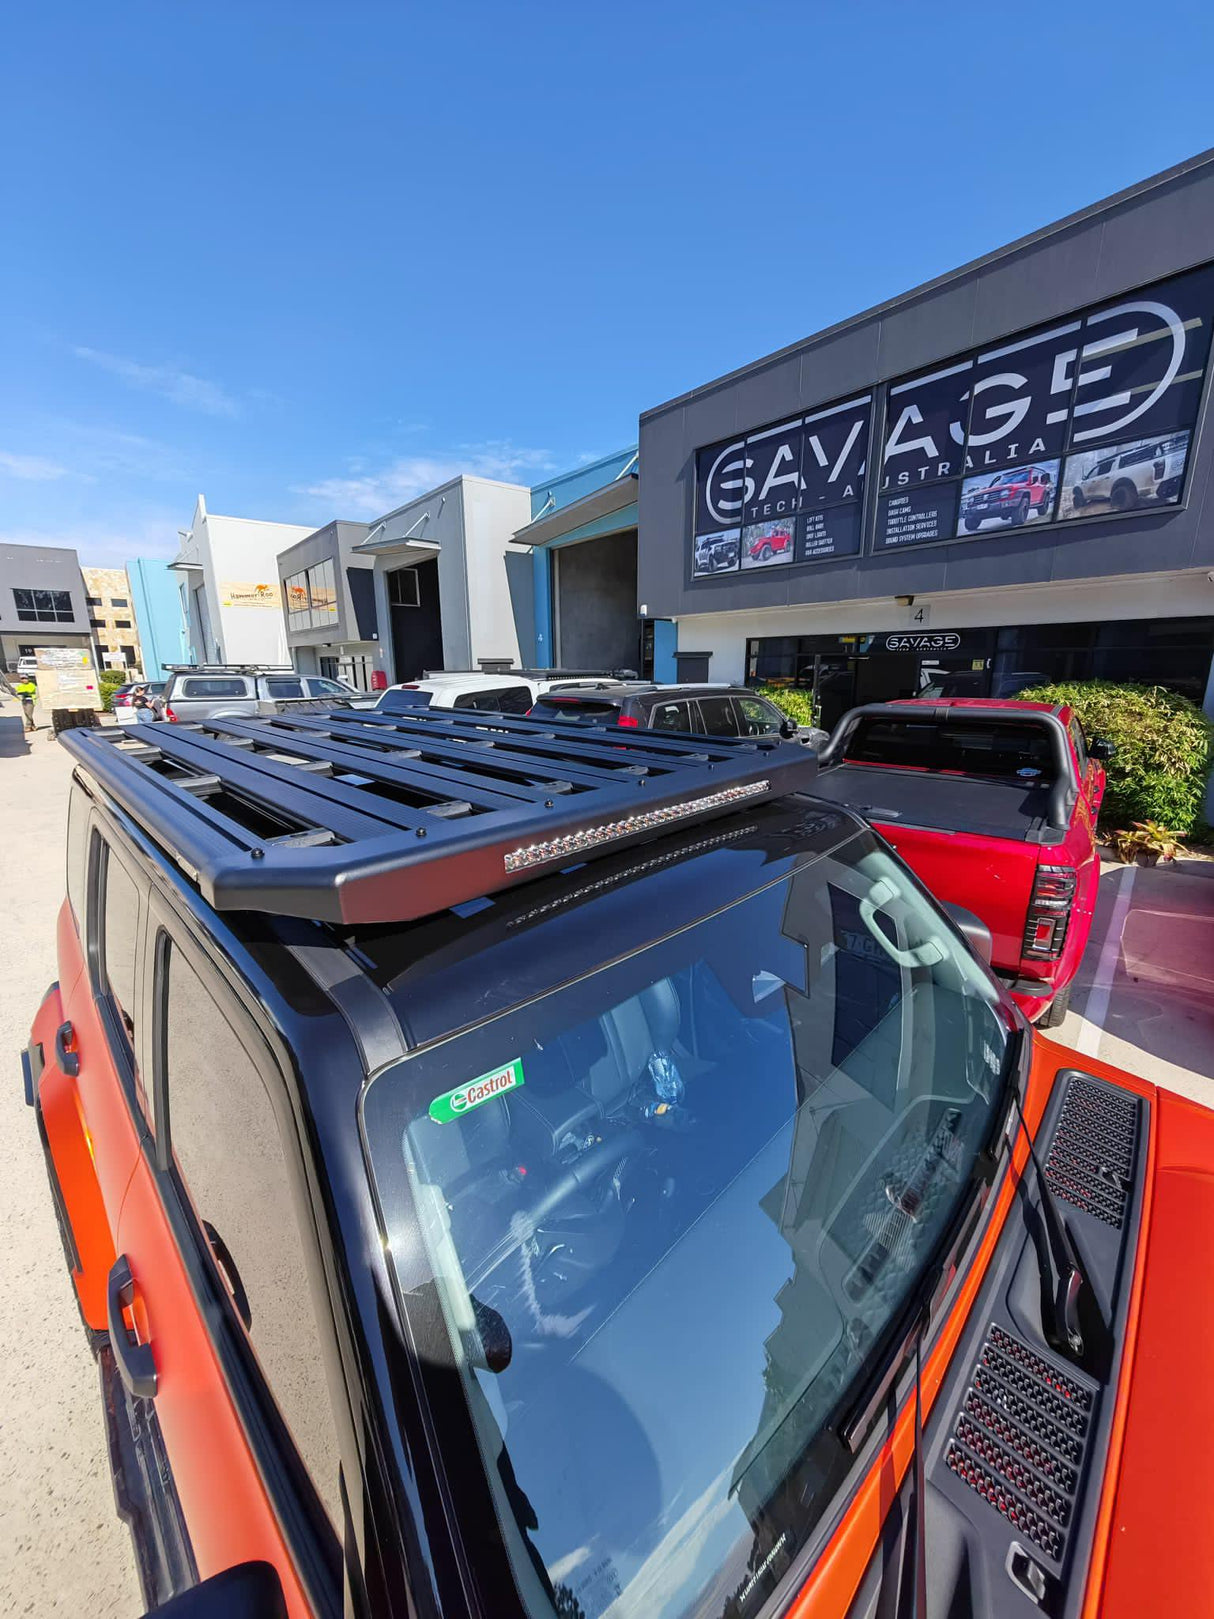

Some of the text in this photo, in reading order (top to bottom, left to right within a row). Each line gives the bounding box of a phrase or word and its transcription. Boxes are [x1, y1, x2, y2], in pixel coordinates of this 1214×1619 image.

[716, 327, 1139, 511] SAVAGE
[750, 496, 803, 518] TECH
[914, 608, 924, 624] 4
[888, 636, 956, 648] SAVAGE
[467, 1070, 513, 1104] Castrol
